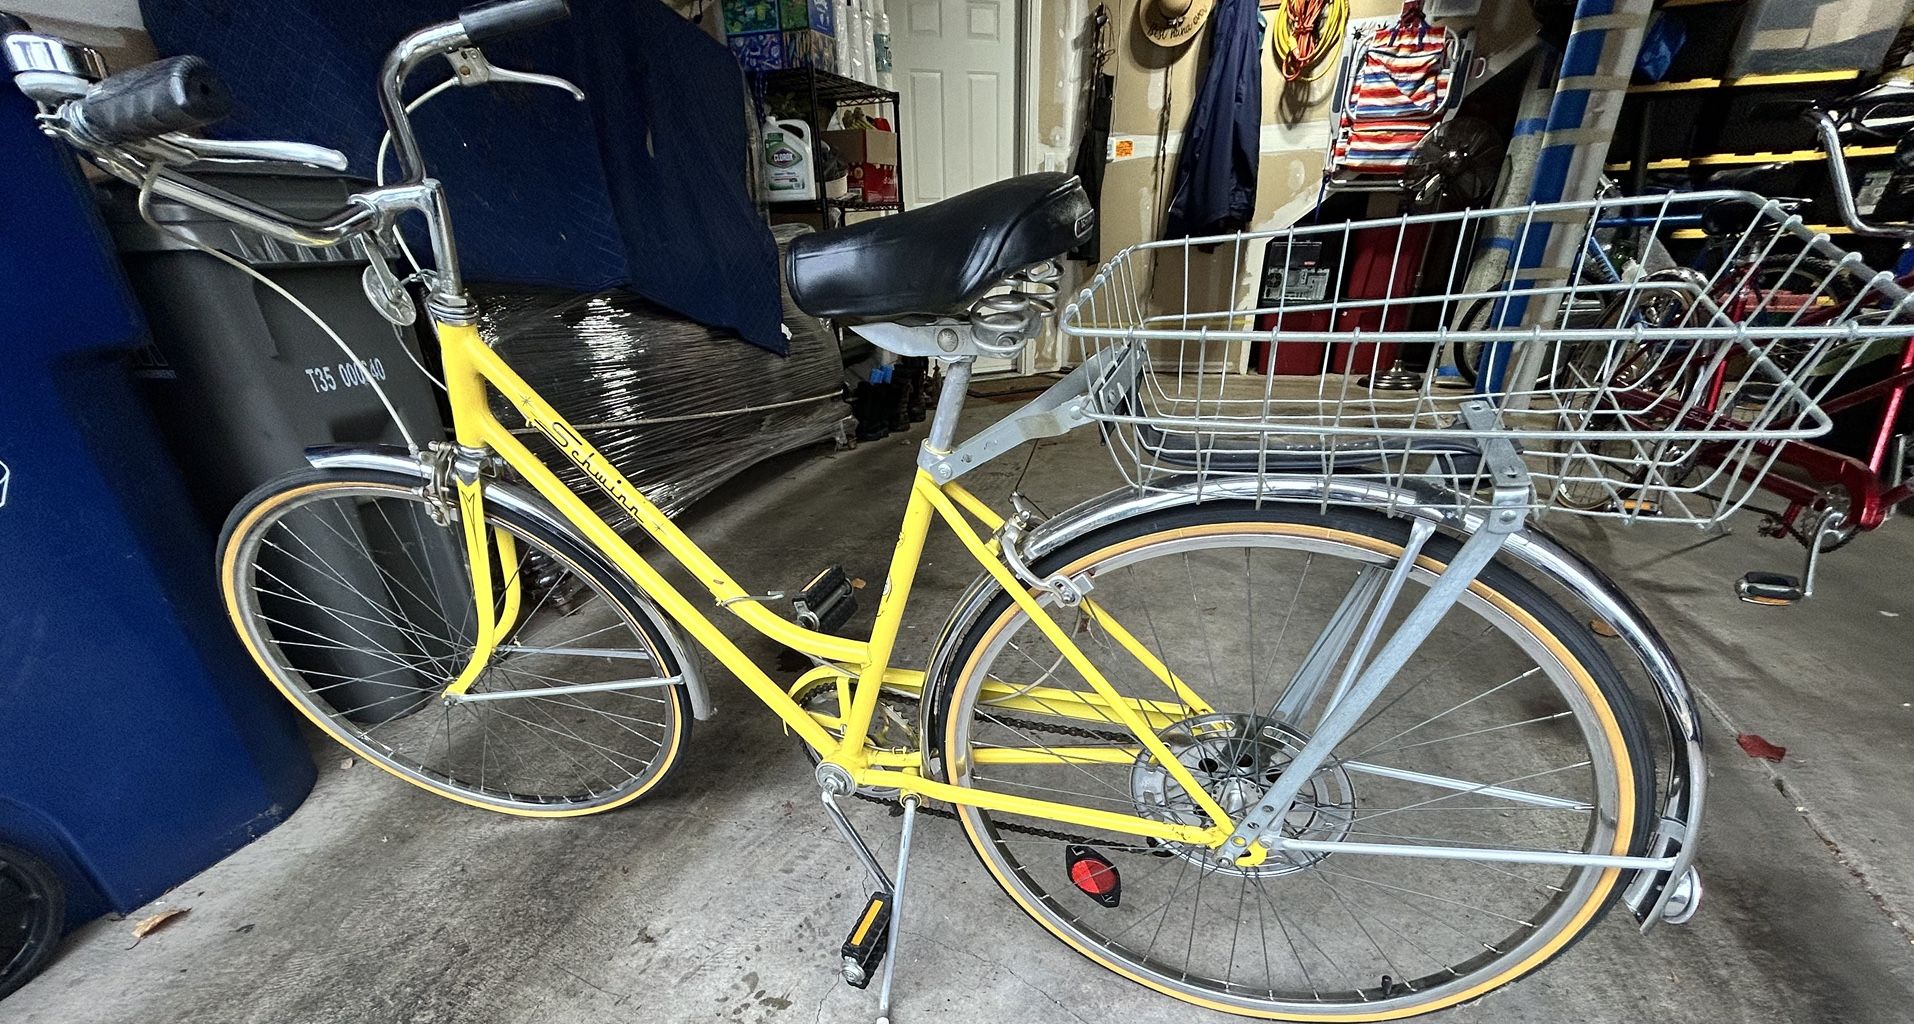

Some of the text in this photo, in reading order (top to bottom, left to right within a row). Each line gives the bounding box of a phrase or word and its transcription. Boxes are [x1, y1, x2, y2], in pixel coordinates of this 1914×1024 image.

[305, 358, 386, 393] T35 00040
[534, 419, 644, 524] Schwinn
